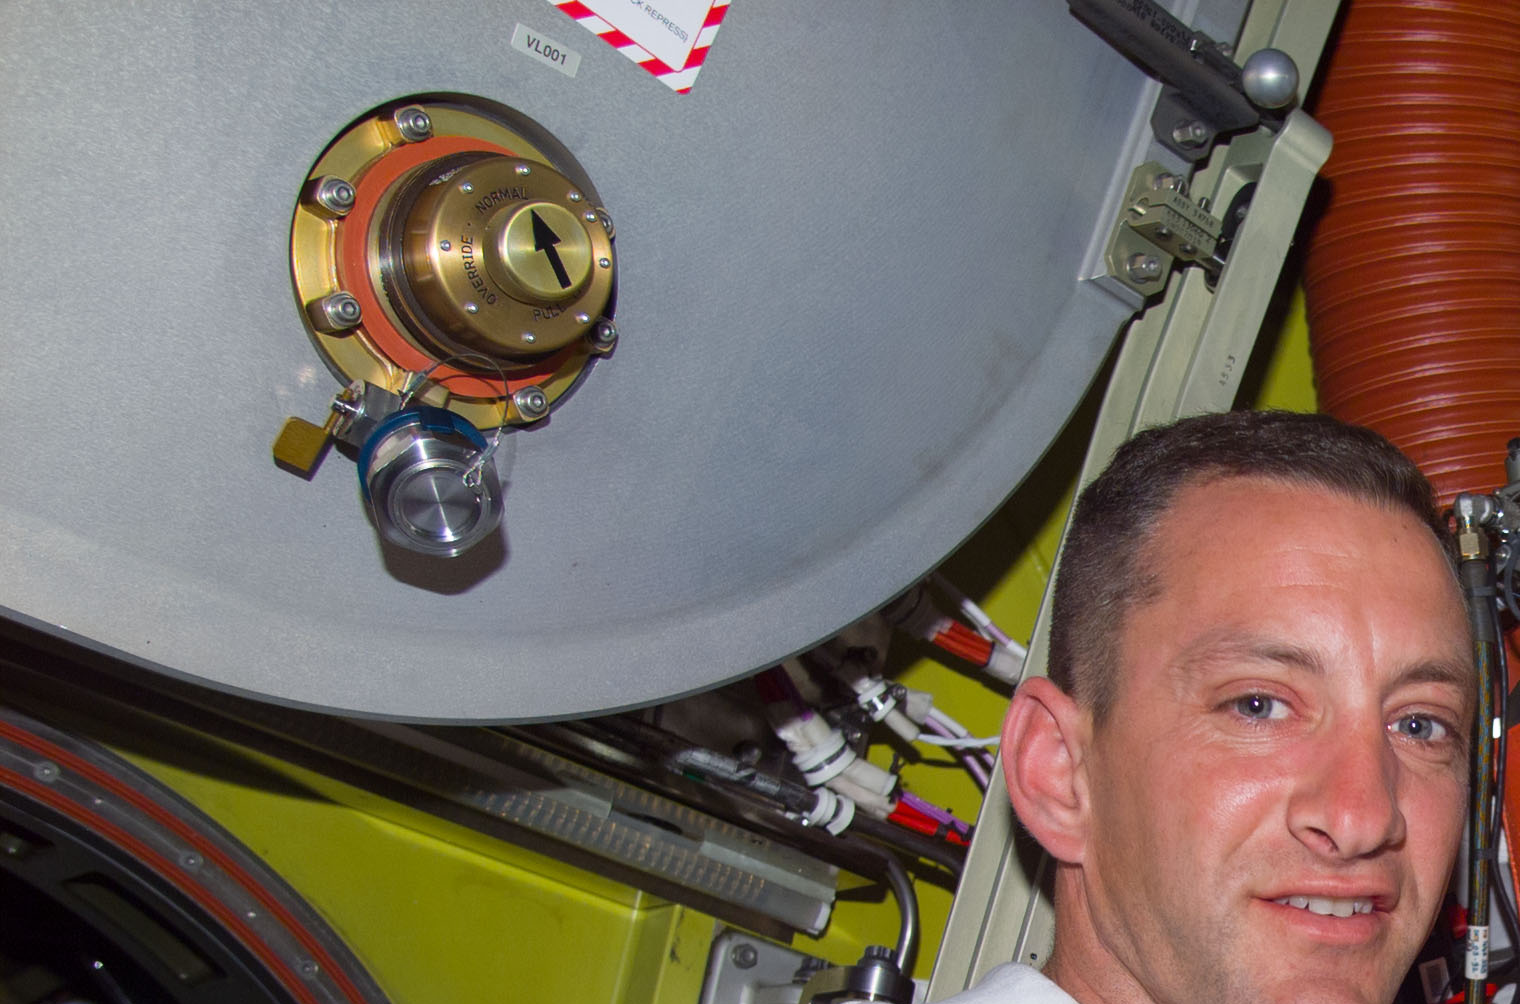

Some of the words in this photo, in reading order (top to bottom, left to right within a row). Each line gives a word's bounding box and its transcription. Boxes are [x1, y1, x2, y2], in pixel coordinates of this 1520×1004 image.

[527, 34, 567, 65] VL001
[475, 187, 528, 215] NORMAL
[461, 235, 497, 305] OVERRIDE
